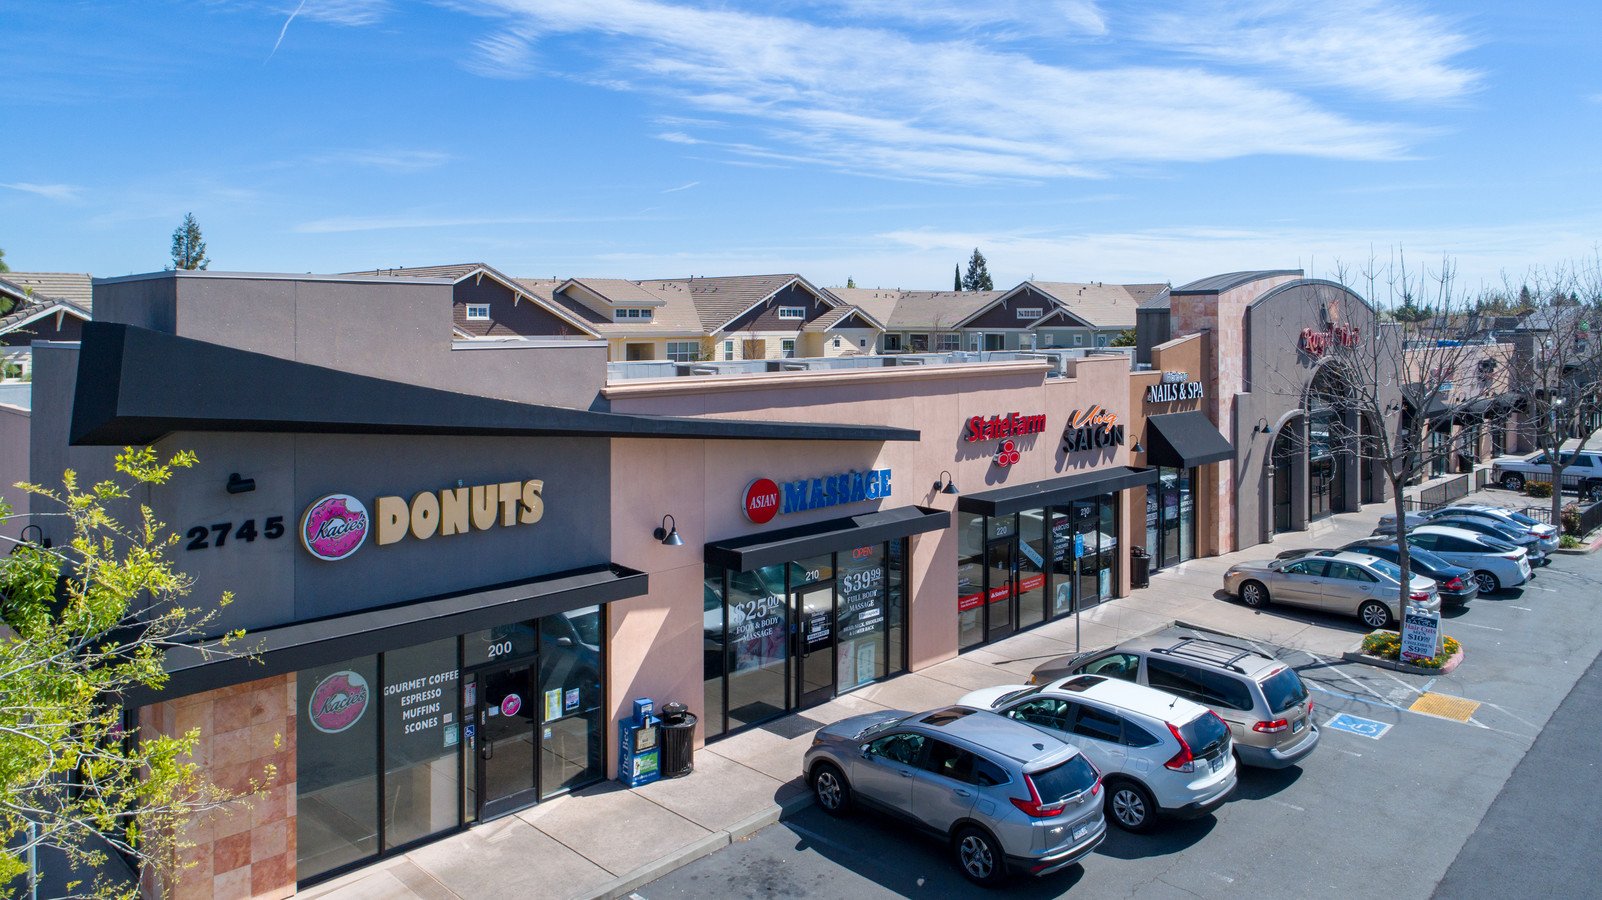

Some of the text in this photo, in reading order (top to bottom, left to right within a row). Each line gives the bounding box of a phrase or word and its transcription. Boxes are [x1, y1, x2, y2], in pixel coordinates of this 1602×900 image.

[1151, 381, 1204, 403] NAILS & SPA
[1062, 425, 1125, 453] SALON
[750, 493, 777, 510] ASIAN
[779, 469, 892, 515] MASSAGE
[375, 479, 545, 546] DONUTS
[186, 515, 285, 551] 2745
[310, 513, 367, 543] Kacie's
[996, 526, 1008, 536] 220
[852, 546, 873, 559] OPEN
[805, 569, 820, 581] 210
[847, 589, 878, 604] FULL BODY
[849, 600, 875, 612] MASSAGE
[736, 623, 754, 635] FOOT
[761, 616, 779, 628] BODY
[743, 627, 773, 642] MASSAGE
[487, 640, 512, 658] 200
[384, 669, 459, 696] GOURMET COFFEE
[401, 687, 442, 707] ESPRESSO
[402, 702, 441, 721] MUFFINS
[404, 716, 438, 735] SCONES
